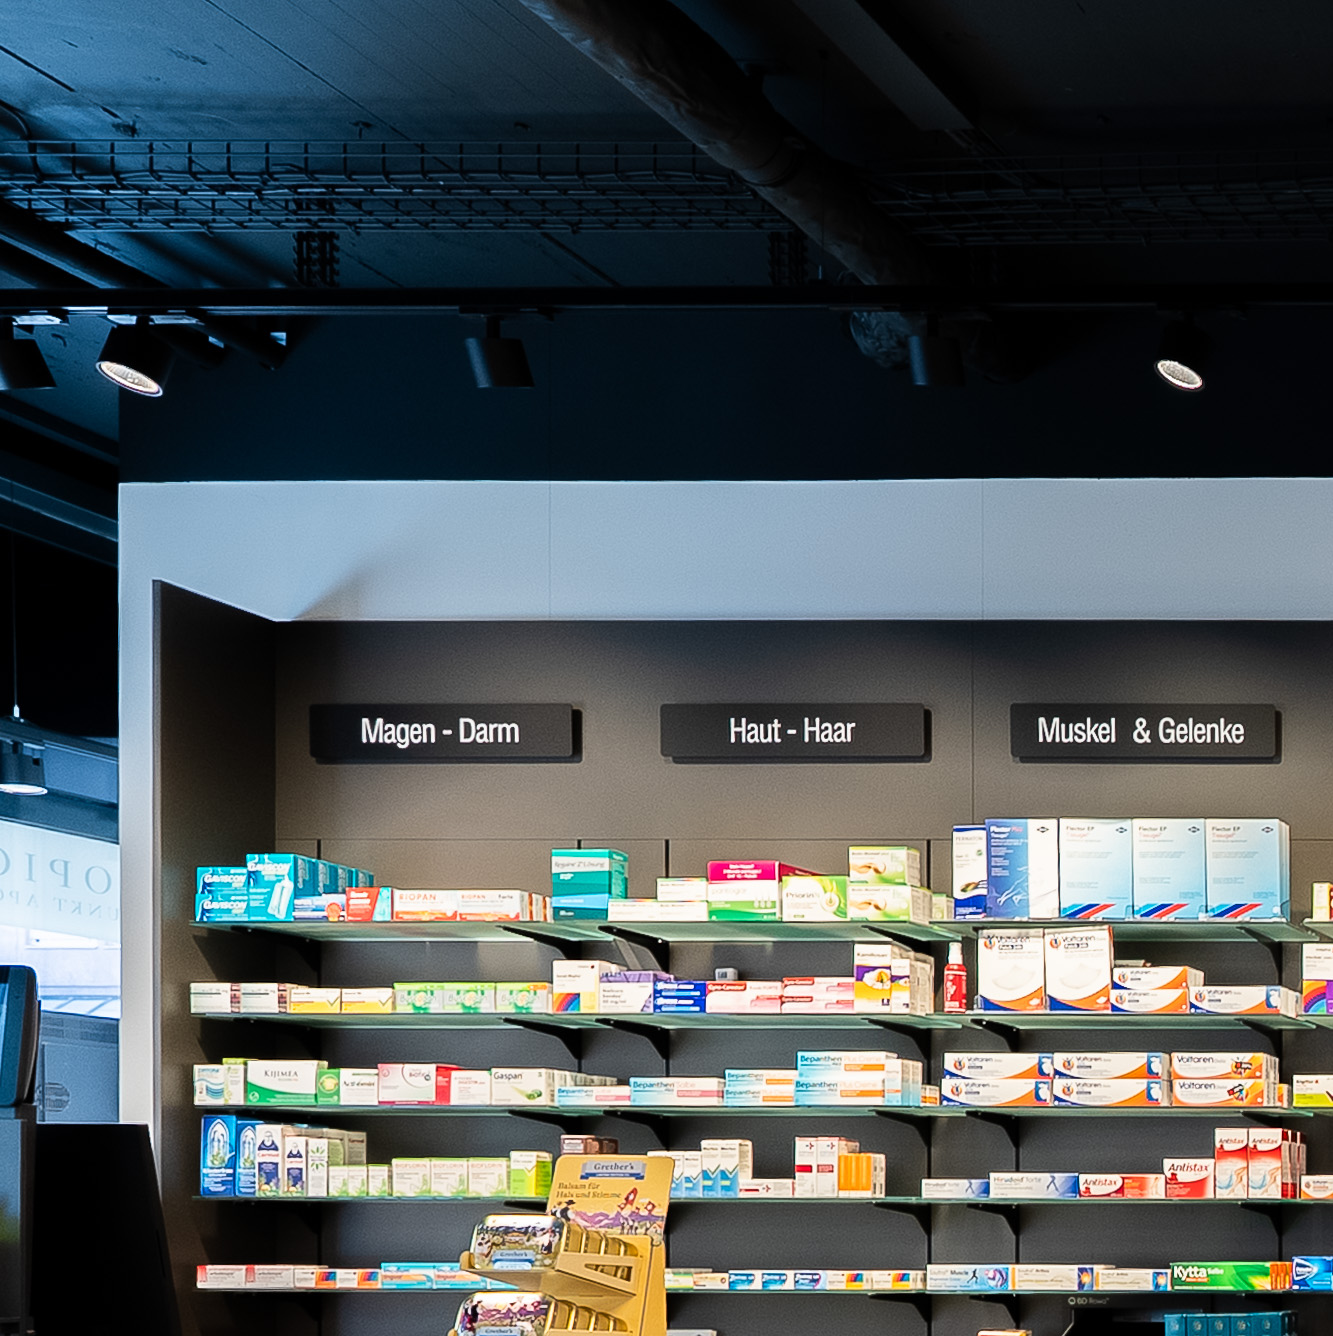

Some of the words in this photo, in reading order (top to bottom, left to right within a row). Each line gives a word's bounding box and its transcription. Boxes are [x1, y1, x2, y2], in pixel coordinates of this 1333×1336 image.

[361, 717, 436, 749] Magen
[459, 717, 520, 744] Darm
[730, 717, 782, 744] Haut
[804, 717, 856, 744] Haar
[1038, 716, 1116, 744] Muskel
[1132, 717, 1152, 744] &
[1158, 716, 1245, 744] Gelenke
[247, 862, 291, 872] GAVISCON
[204, 874, 247, 883] GAVISCON
[203, 900, 247, 910] GAVISCON
[1062, 935, 1095, 943] Voltaren
[1176, 1055, 1213, 1064] Voltaren
[264, 1069, 298, 1077] KIJIMEA
[494, 1071, 522, 1080] Gaspan
[633, 1081, 674, 1089] Bepanthen
[1178, 1081, 1215, 1090] Voltaren
[1218, 1137, 1244, 1145] Antistax
[1251, 1137, 1278, 1145] Antistax
[594, 1162, 634, 1171] Grether's
[1168, 1162, 1208, 1172] Antistax
[1083, 1178, 1117, 1187] Antistax
[1174, 1265, 1208, 1282] Kytta
